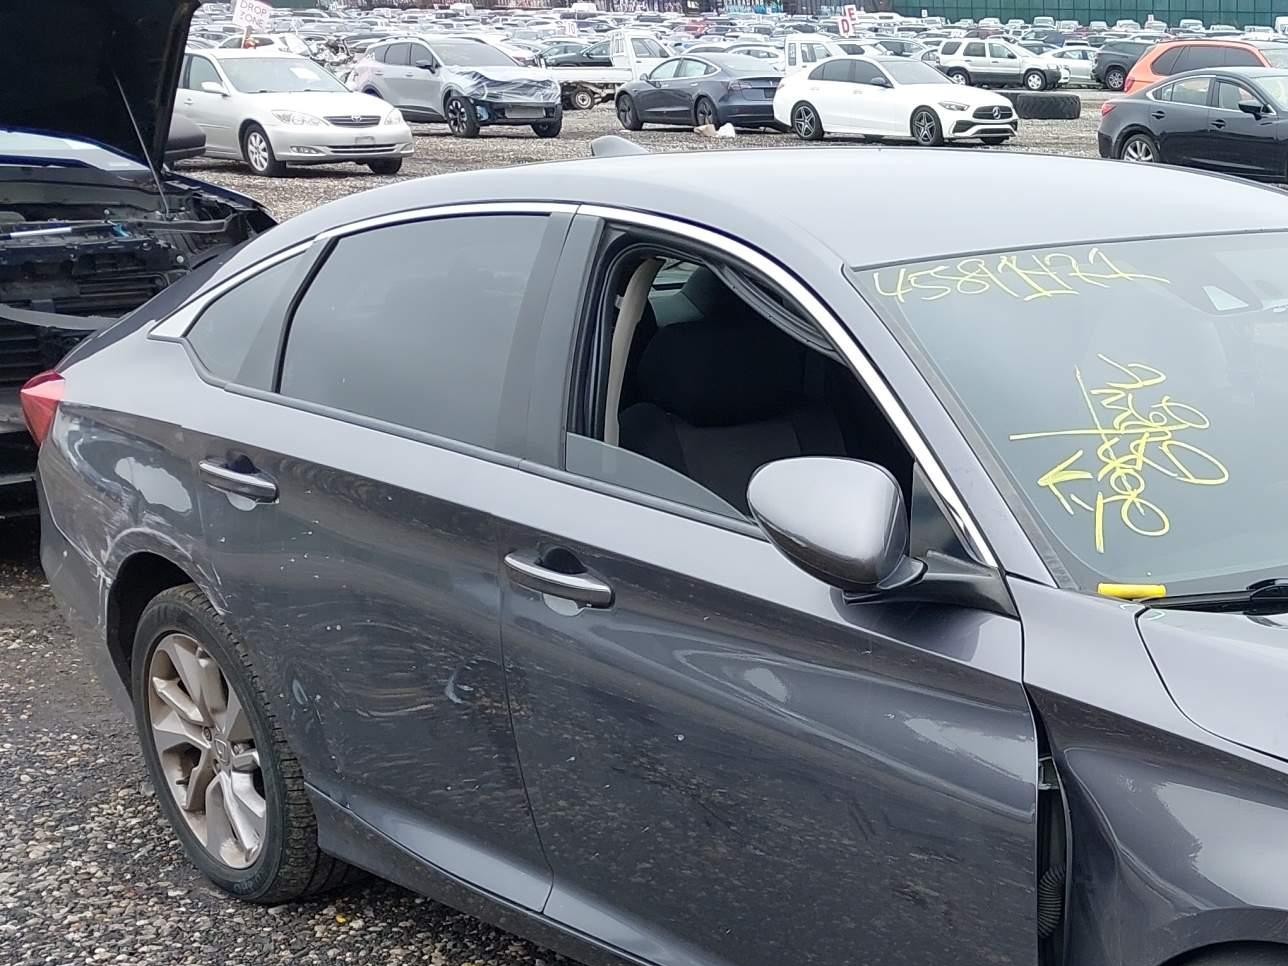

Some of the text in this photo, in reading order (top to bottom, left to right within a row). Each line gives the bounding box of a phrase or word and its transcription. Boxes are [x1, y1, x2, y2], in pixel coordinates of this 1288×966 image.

[240, 0, 267, 16] DROP
[848, 8, 856, 21] E
[240, 11, 264, 27] ZONE
